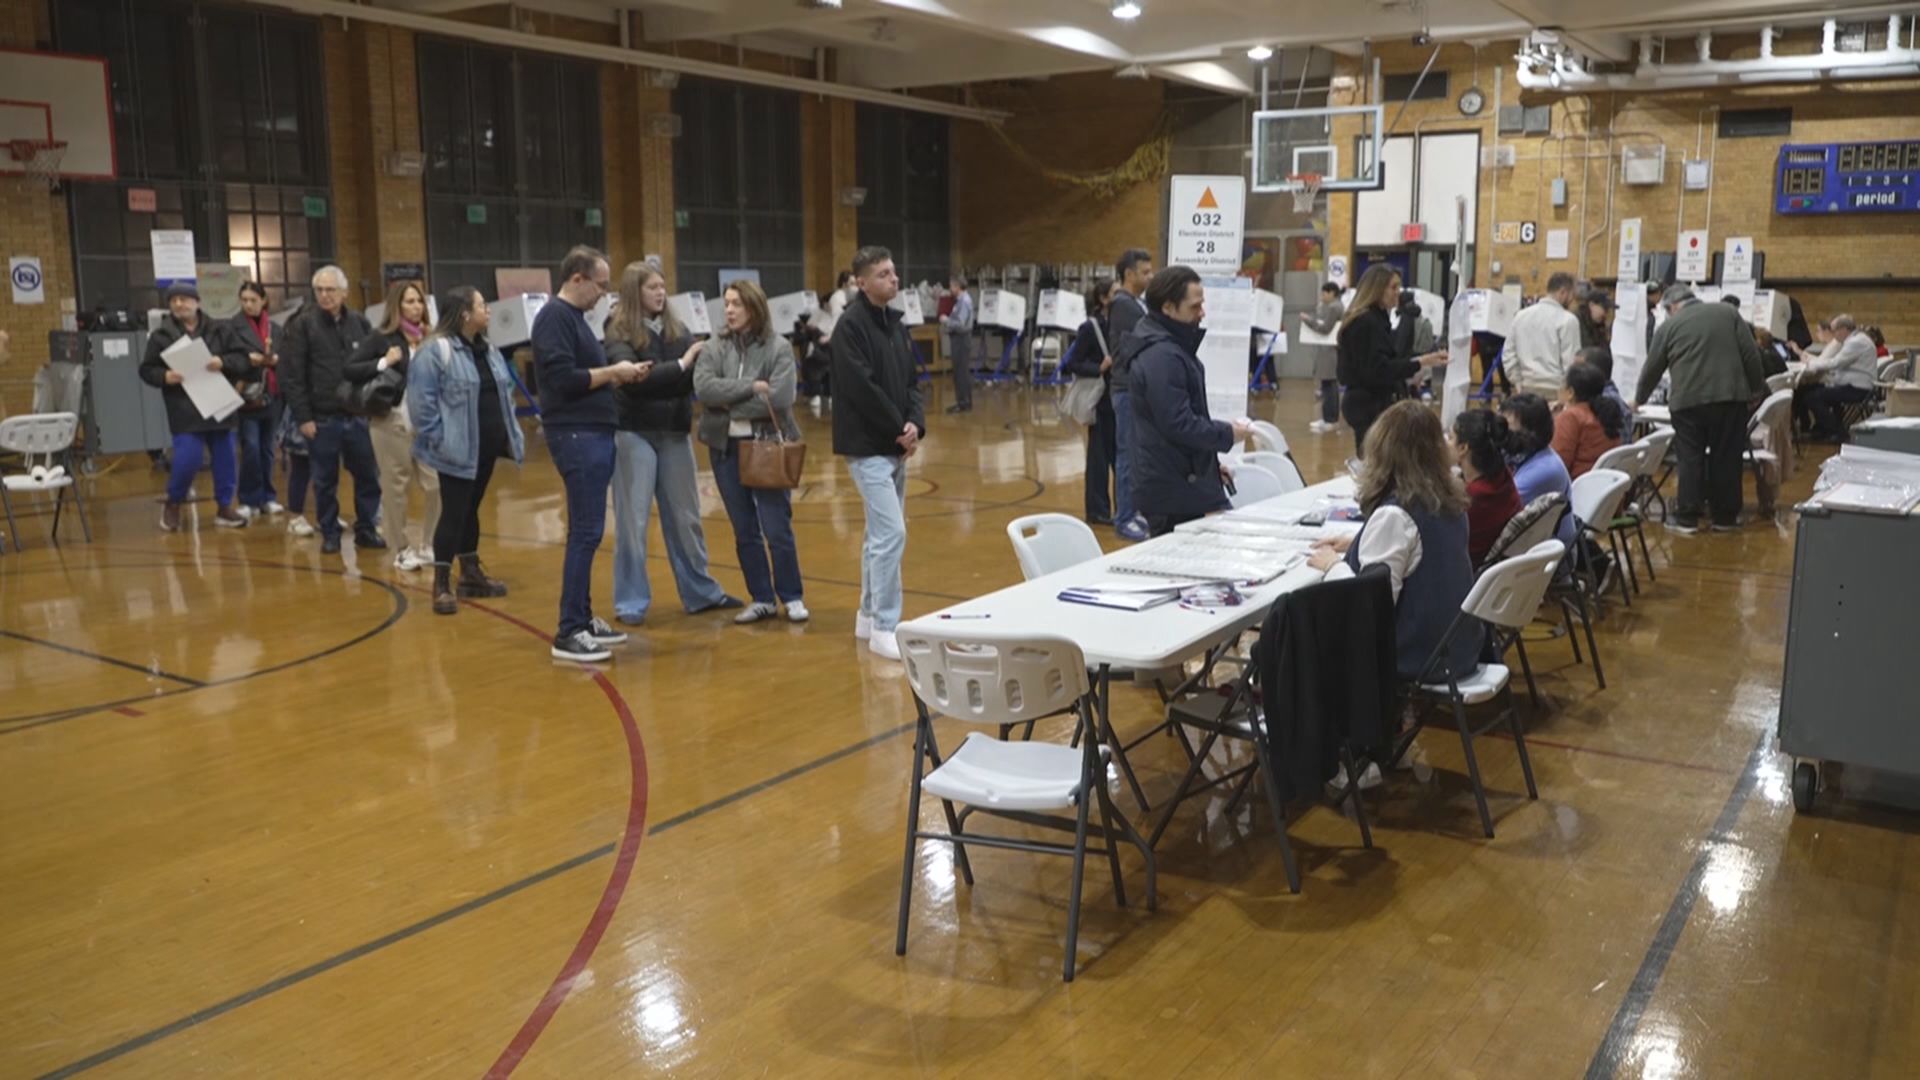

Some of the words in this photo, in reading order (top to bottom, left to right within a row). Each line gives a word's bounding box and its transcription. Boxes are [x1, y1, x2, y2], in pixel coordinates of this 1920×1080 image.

[1866, 176, 1872, 186] 2
[1883, 175, 1890, 186] 3
[1902, 174, 1909, 185] 4
[1856, 191, 1896, 207] period
[1192, 213, 1221, 226] 032
[1179, 230, 1207, 238] Election
[1209, 230, 1234, 238] District
[1522, 222, 1534, 242] 6
[1196, 241, 1215, 254] 28
[1175, 256, 1208, 265] Assembly
